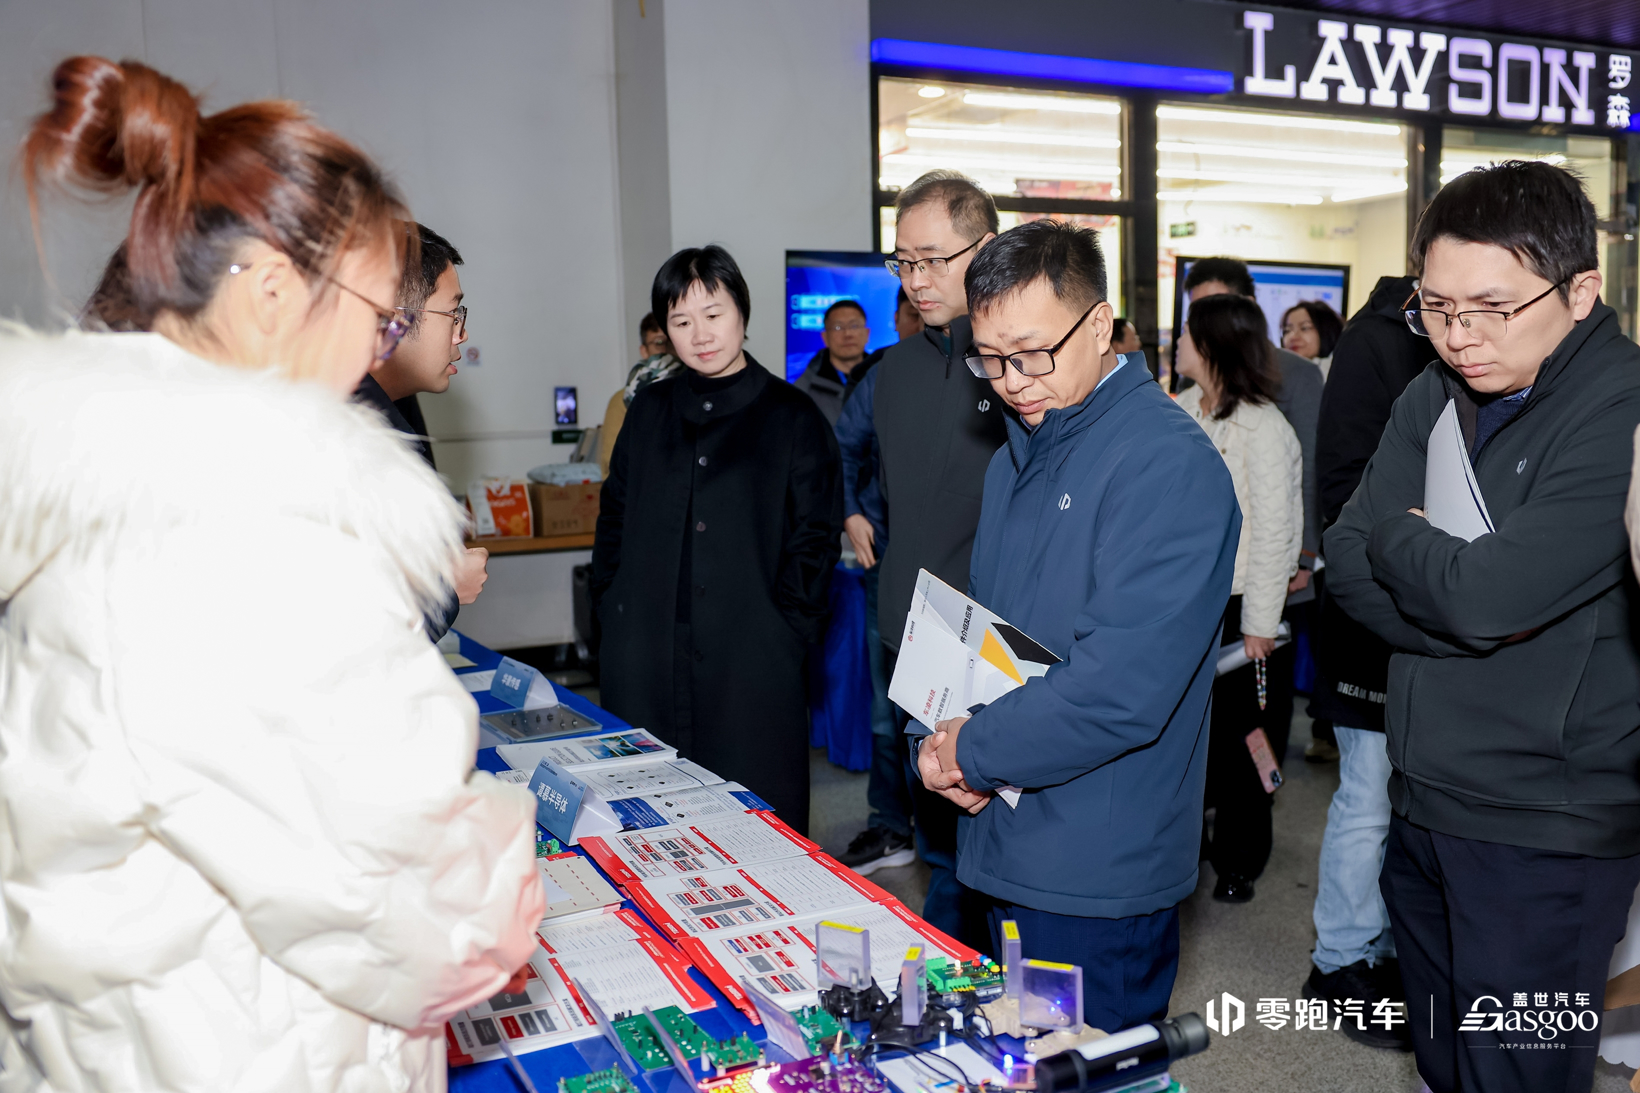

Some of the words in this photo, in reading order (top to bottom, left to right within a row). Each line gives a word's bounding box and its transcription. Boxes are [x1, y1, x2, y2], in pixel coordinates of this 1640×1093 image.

[1243, 10, 1596, 125] LAWSON
[1606, 53, 1632, 128] 罗森
[1337, 681, 1367, 700] DREAM
